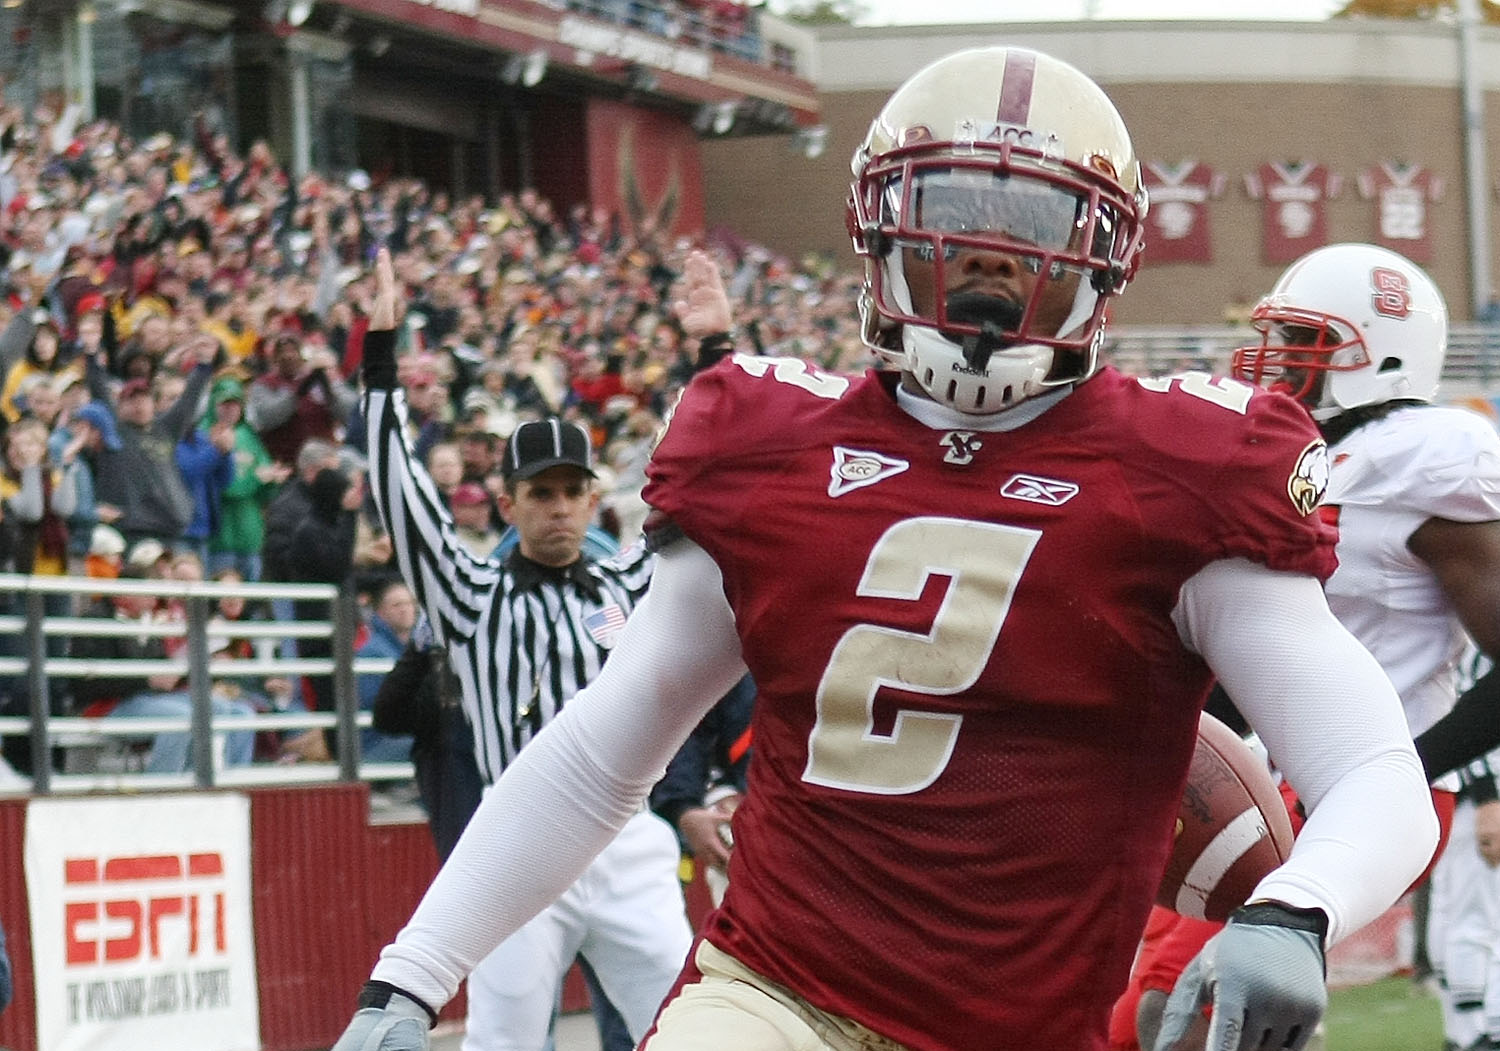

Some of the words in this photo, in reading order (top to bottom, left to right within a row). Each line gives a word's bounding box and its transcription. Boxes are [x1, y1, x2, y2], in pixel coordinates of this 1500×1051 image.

[847, 464, 872, 477] ACC
[801, 516, 1043, 795] 2
[65, 852, 226, 965] ESPN
